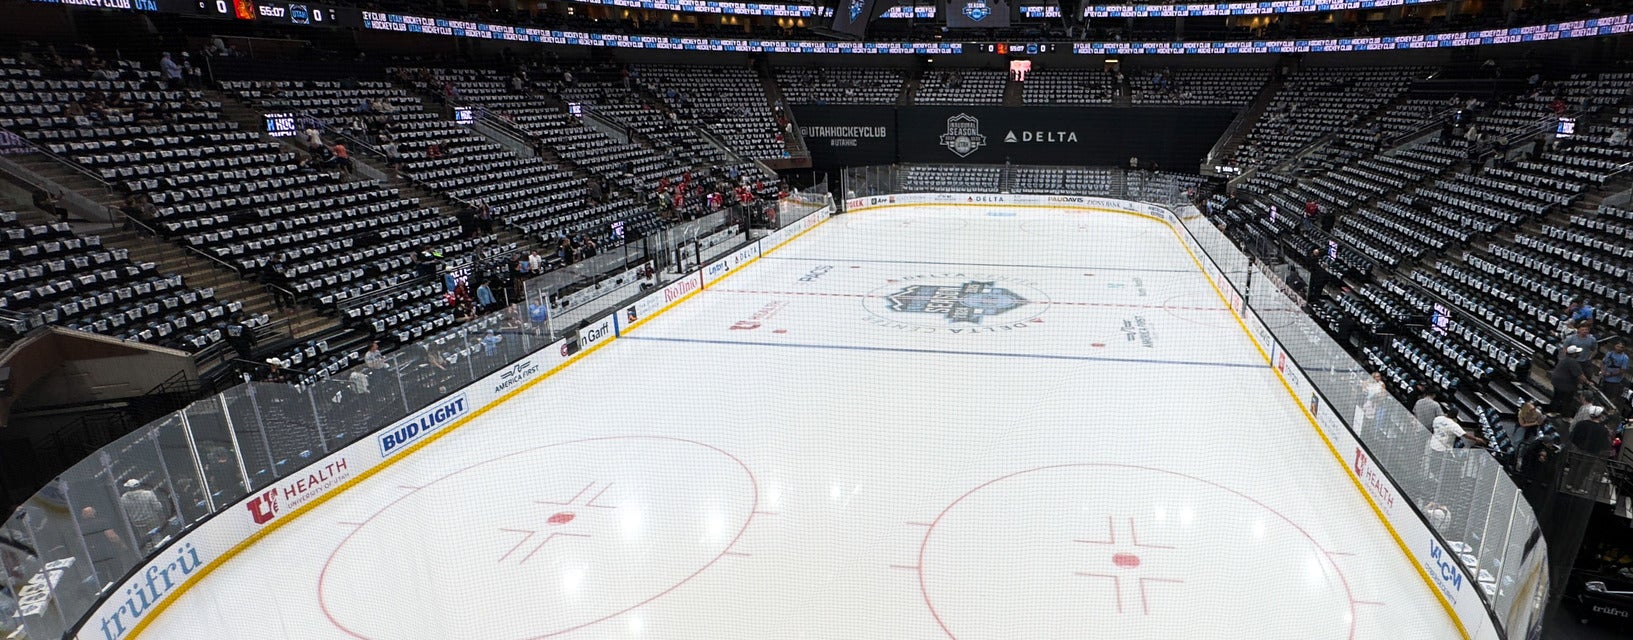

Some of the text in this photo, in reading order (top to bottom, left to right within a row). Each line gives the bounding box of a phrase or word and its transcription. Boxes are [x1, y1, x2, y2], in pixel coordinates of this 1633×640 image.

[216, 0, 227, 13] 0
[259, 6, 284, 17] 55:07
[313, 10, 322, 21] 0
[801, 126, 886, 138] @UTAHHOCKEYCLUB
[950, 128, 977, 136] SEASON
[1022, 131, 1078, 142] DELTA
[740, 246, 757, 260] DELTA
[588, 322, 609, 343] Garff
[495, 374, 522, 393] AMERICA
[523, 365, 539, 379] FIRST
[383, 398, 464, 451] BUD LIGHT
[284, 458, 347, 500] HEALTH
[1366, 468, 1394, 507] HEALTH
[288, 487, 324, 509] UNIVERSITY
[334, 473, 349, 484] UTAH
[100, 542, 203, 640] trüfrü
